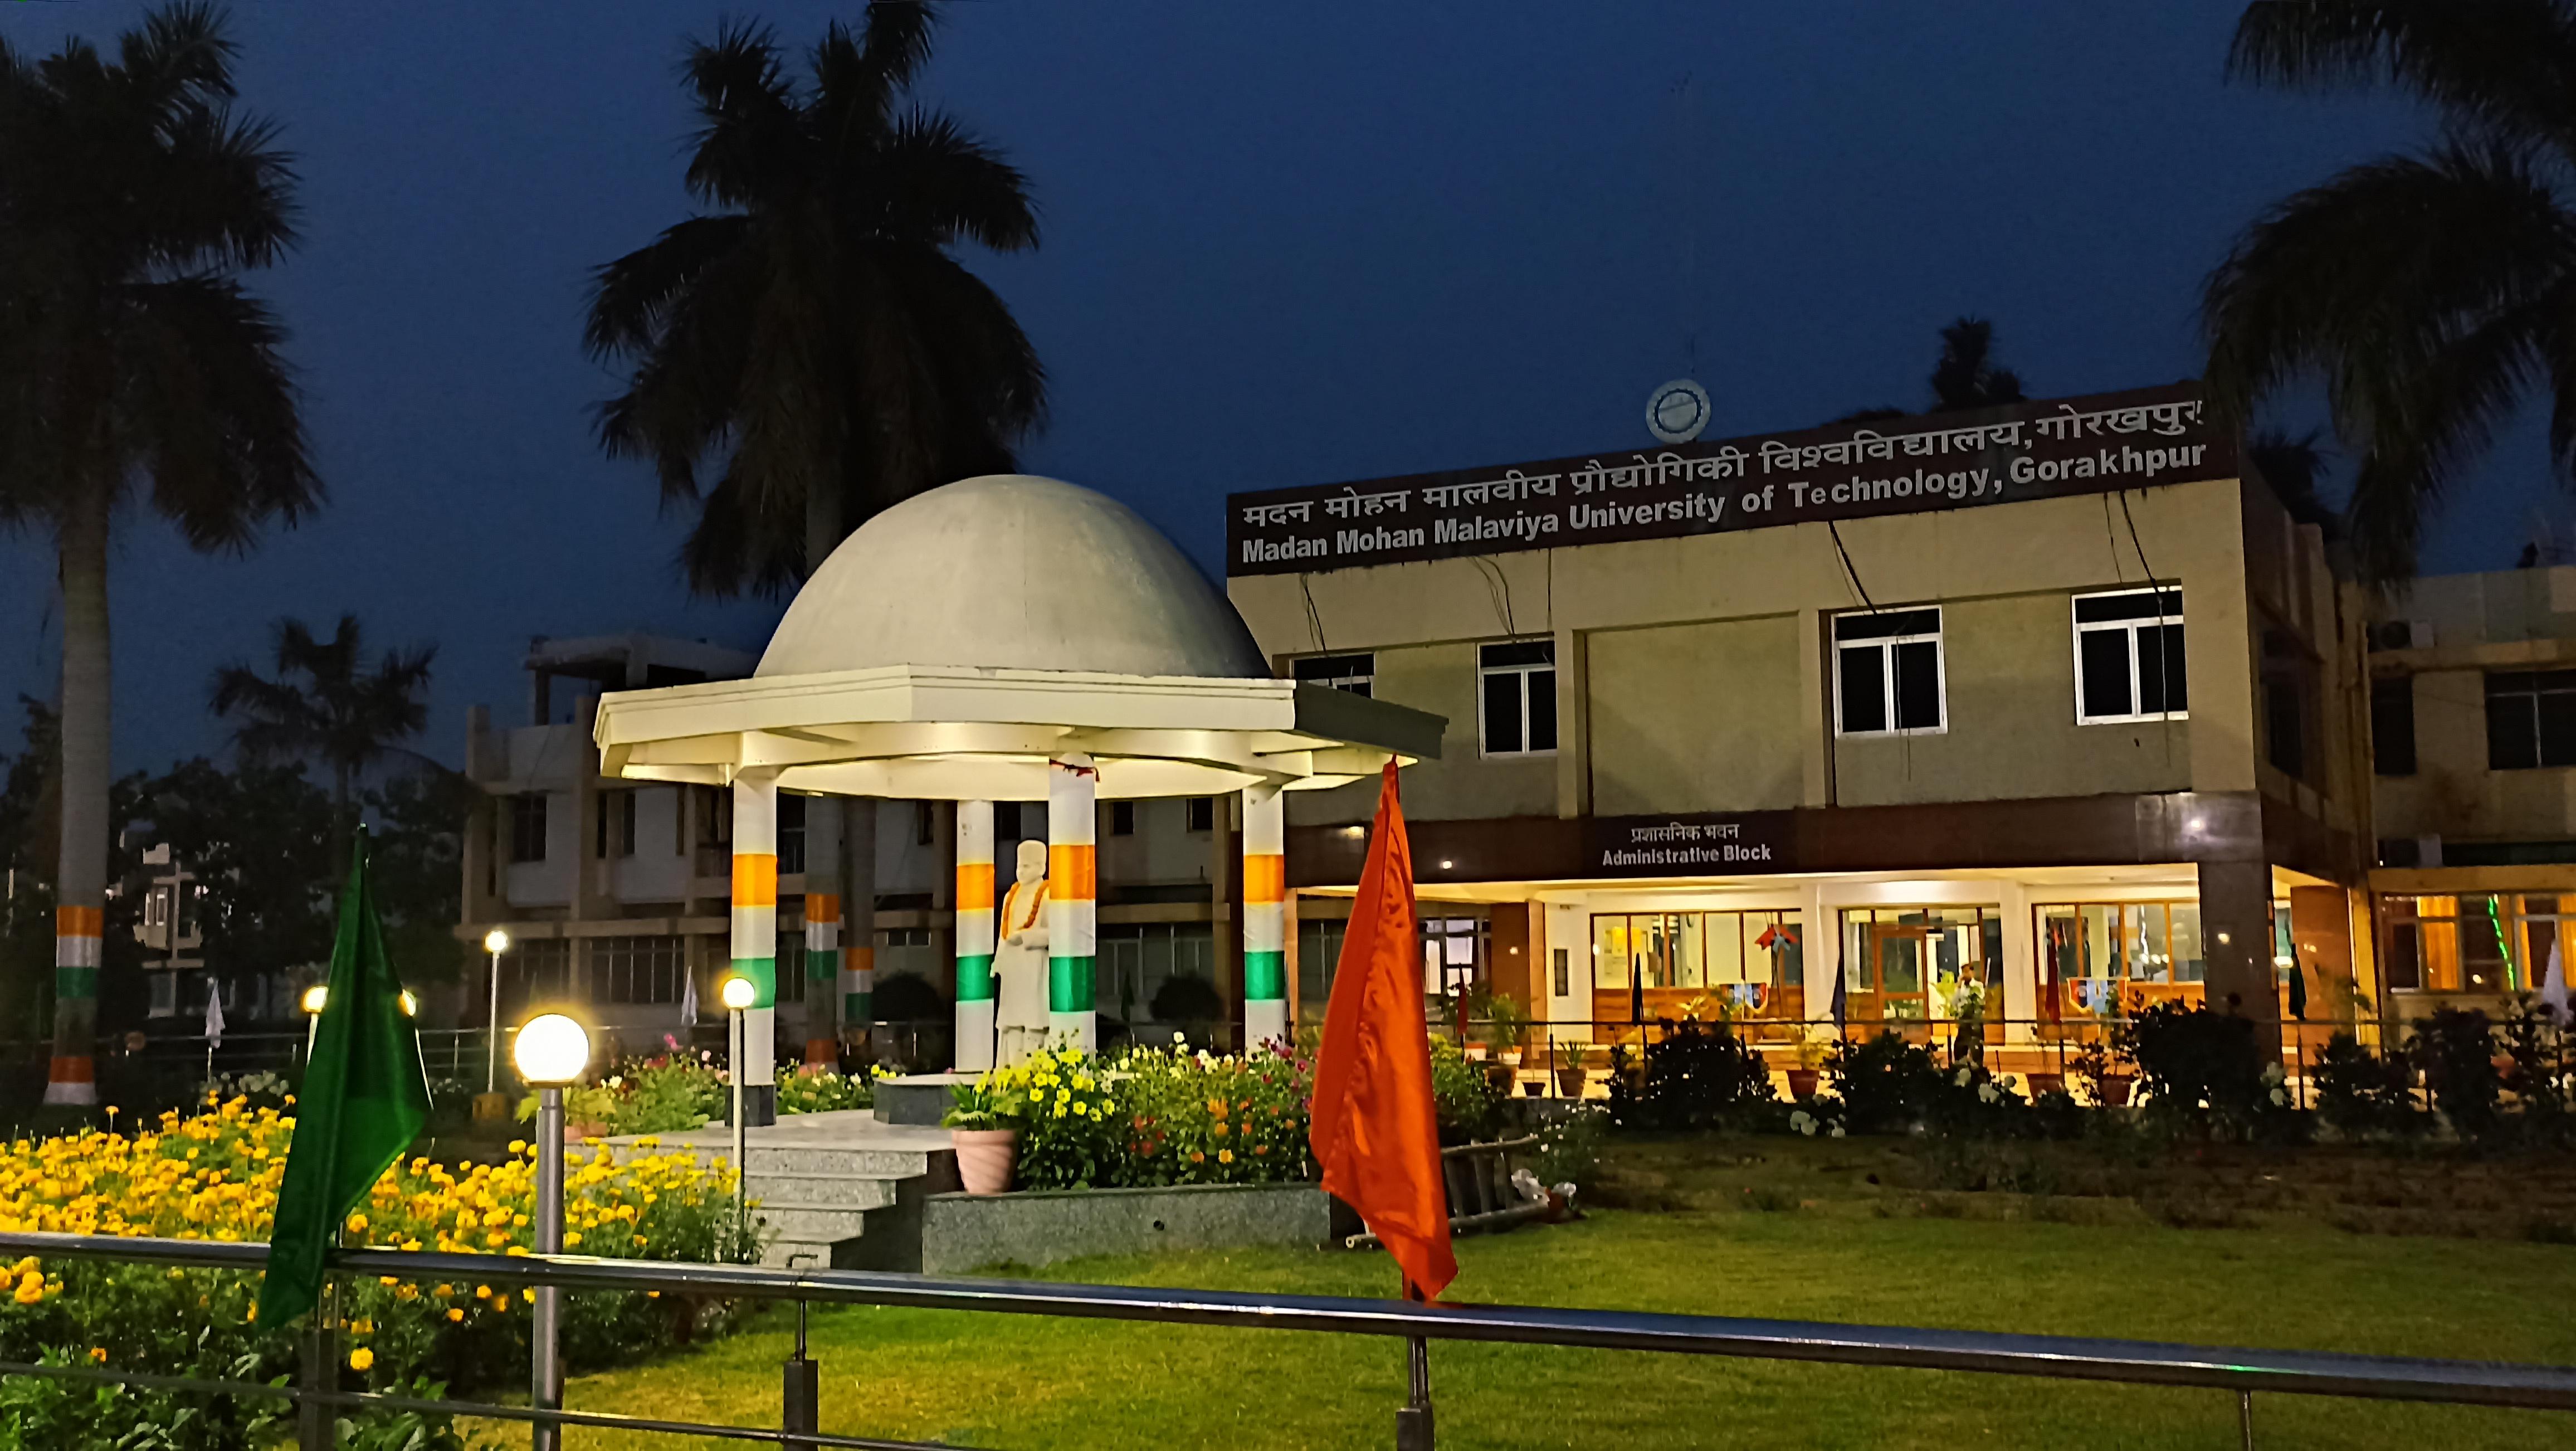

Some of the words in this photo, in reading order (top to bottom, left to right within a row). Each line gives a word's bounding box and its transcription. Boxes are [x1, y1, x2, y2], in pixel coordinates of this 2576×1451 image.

[1242, 535, 1327, 563] Madan
[1337, 525, 1424, 554] Mohan
[1435, 510, 1559, 542] Malaviya
[1569, 492, 1725, 530] University
[1741, 485, 1774, 513] of
[1788, 468, 2003, 508] Technology,
[2009, 444, 2207, 484] Gorakhpur
[1243, 500, 1314, 527] मदन
[1325, 486, 1412, 519] मोहन
[1422, 469, 1562, 508] मालवीय
[1570, 446, 1749, 495] प्रौद्योगिकी
[1603, 847, 1719, 865] Administrative
[1724, 843, 1772, 861] Block
[1704, 823, 1740, 839] भवन
